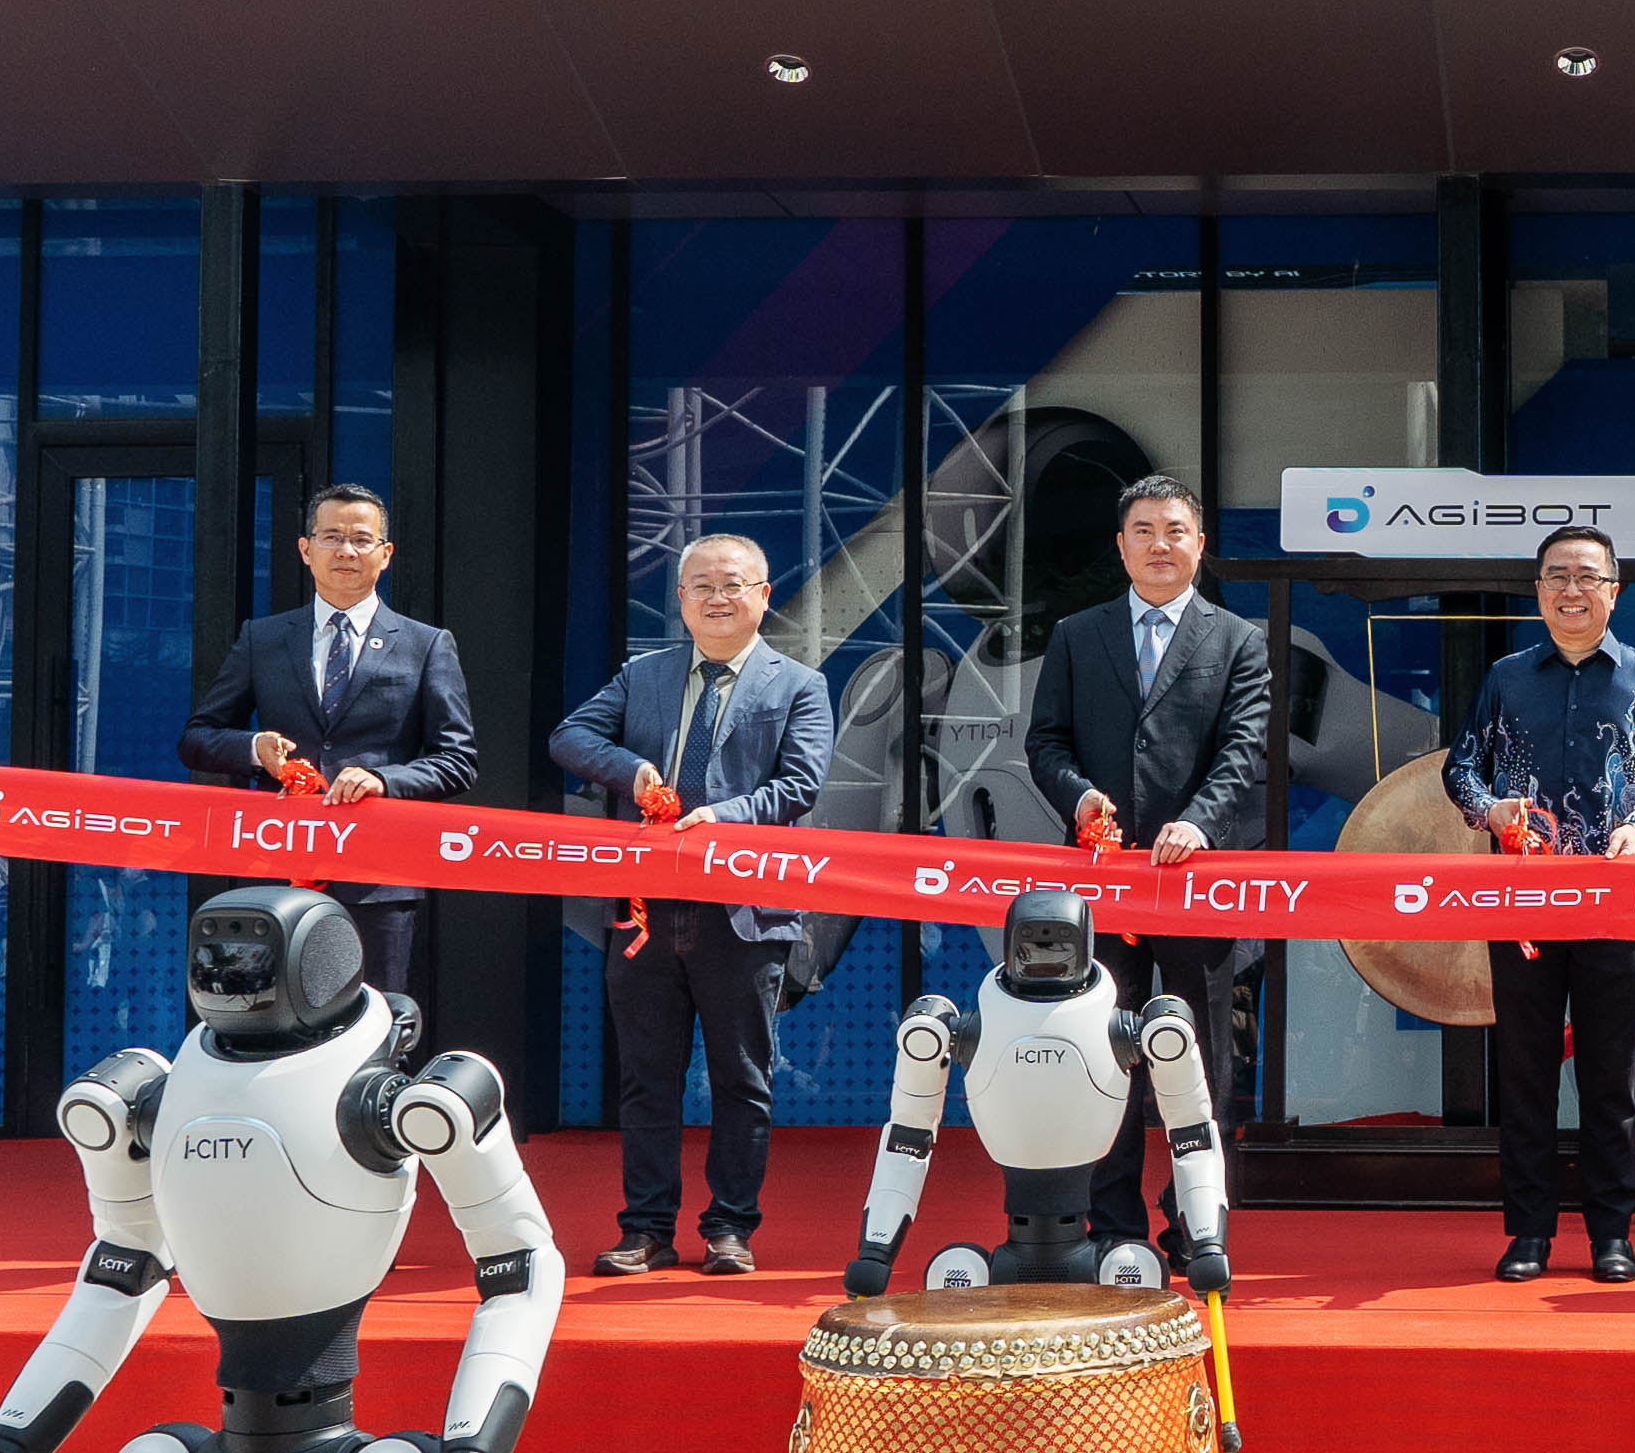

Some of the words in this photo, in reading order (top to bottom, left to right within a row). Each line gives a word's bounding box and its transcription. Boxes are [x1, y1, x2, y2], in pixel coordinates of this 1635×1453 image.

[231, 810, 356, 853] i-CITY
[704, 841, 830, 883] i-CITY
[1184, 872, 1309, 913] i-CITY
[1014, 1047, 1065, 1064] i-CITY
[184, 1134, 254, 1159] i-CITY
